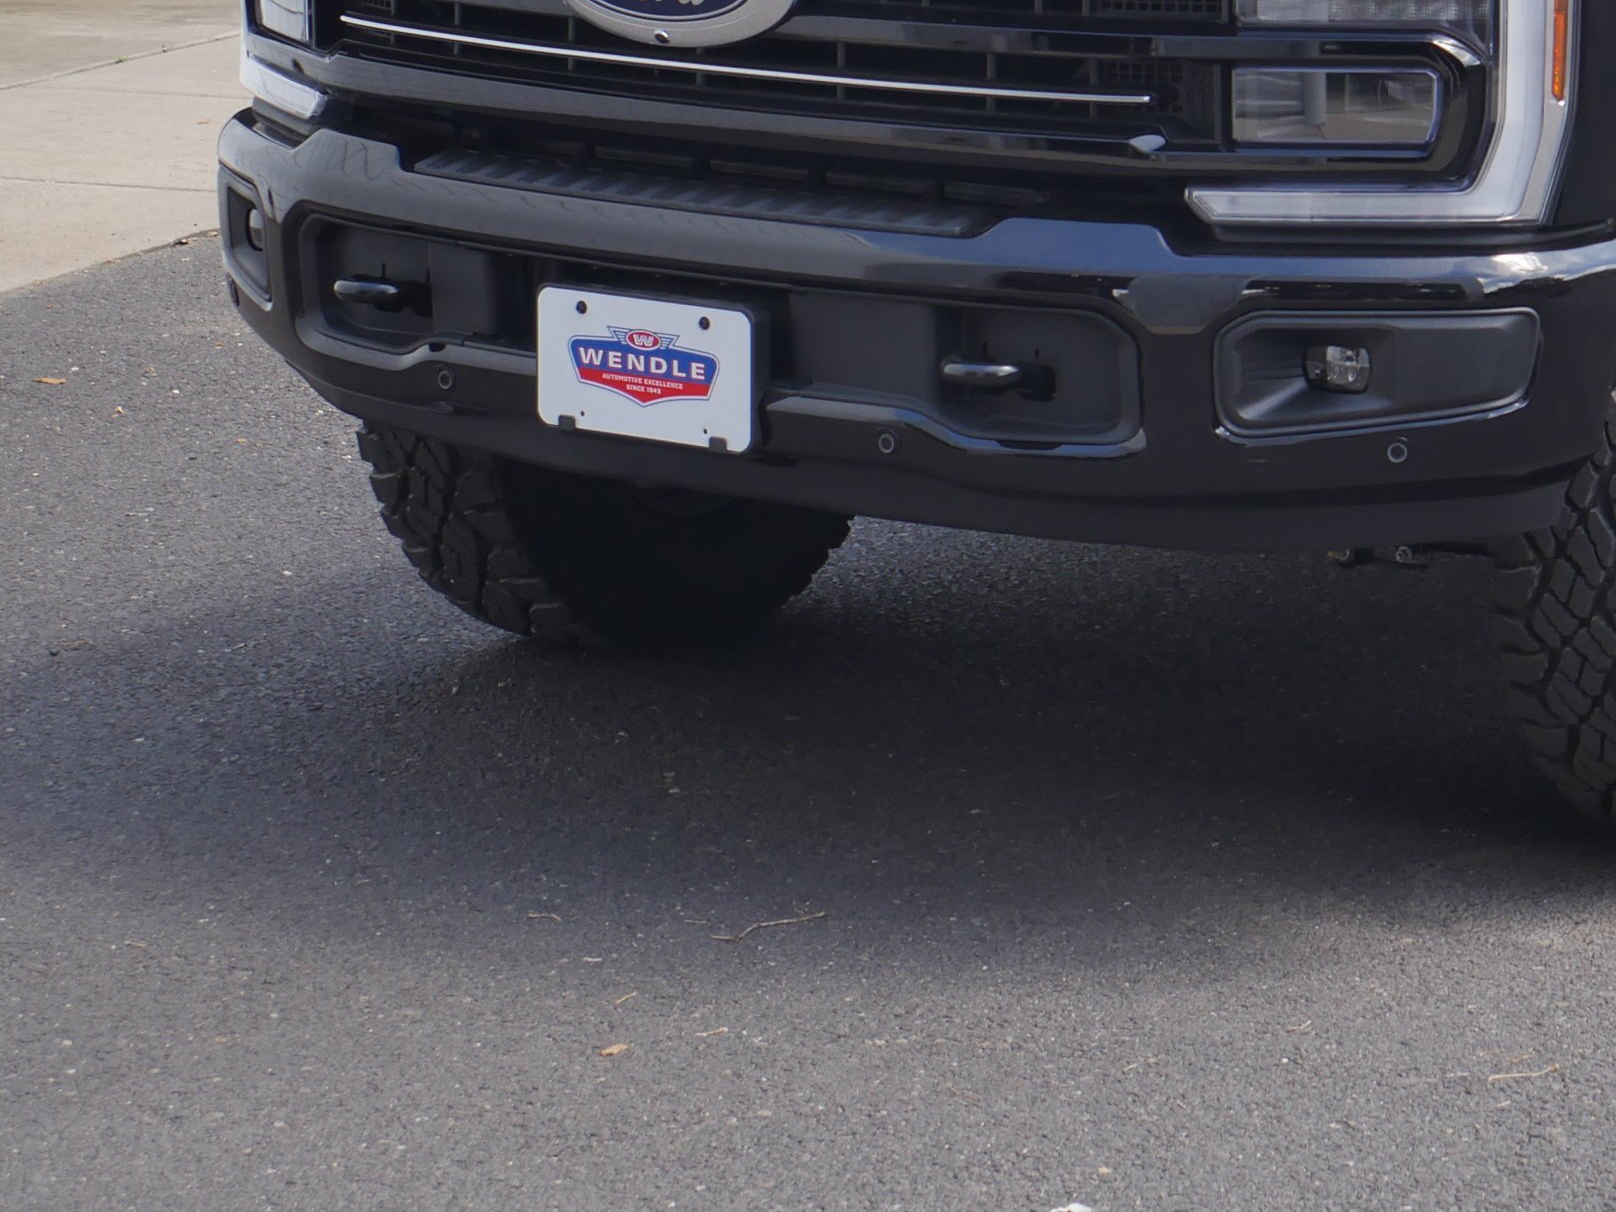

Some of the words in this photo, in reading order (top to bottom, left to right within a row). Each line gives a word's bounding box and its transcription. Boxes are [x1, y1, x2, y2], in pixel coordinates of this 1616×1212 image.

[578, 346, 706, 381] WENDLE
[602, 372, 643, 385] AUTOMOTIVE
[643, 378, 684, 390] EXCELLENCE
[626, 383, 645, 393] SINCE
